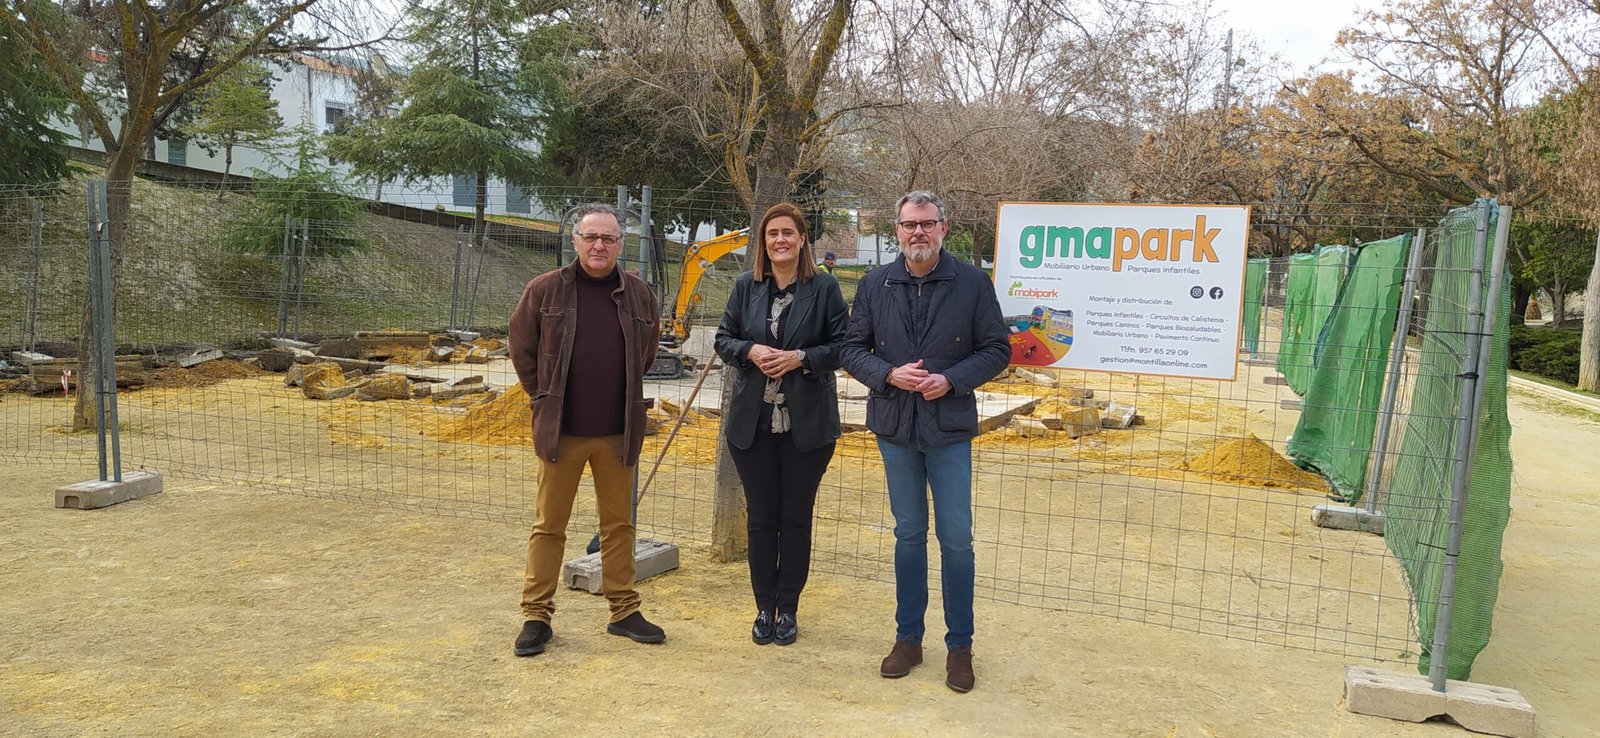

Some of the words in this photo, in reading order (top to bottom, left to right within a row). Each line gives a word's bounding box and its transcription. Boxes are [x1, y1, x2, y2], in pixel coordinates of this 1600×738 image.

[1020, 215, 1222, 272] gmapark
[1044, 262, 1080, 271] Mobiliario
[1127, 265, 1161, 275] Parques
[1162, 266, 1200, 276] Infantiles
[1014, 288, 1058, 299] mobipark
[1088, 296, 1116, 304] Montaje
[1086, 310, 1112, 318] Parques
[1114, 312, 1144, 320] Infantiles
[1086, 320, 1114, 328] Parques
[1146, 323, 1174, 332] Parques
[1176, 324, 1222, 333] Biosaludables
[1092, 330, 1124, 338] Mobiliario
[1100, 356, 1208, 369] gestion@montillaonline.com
